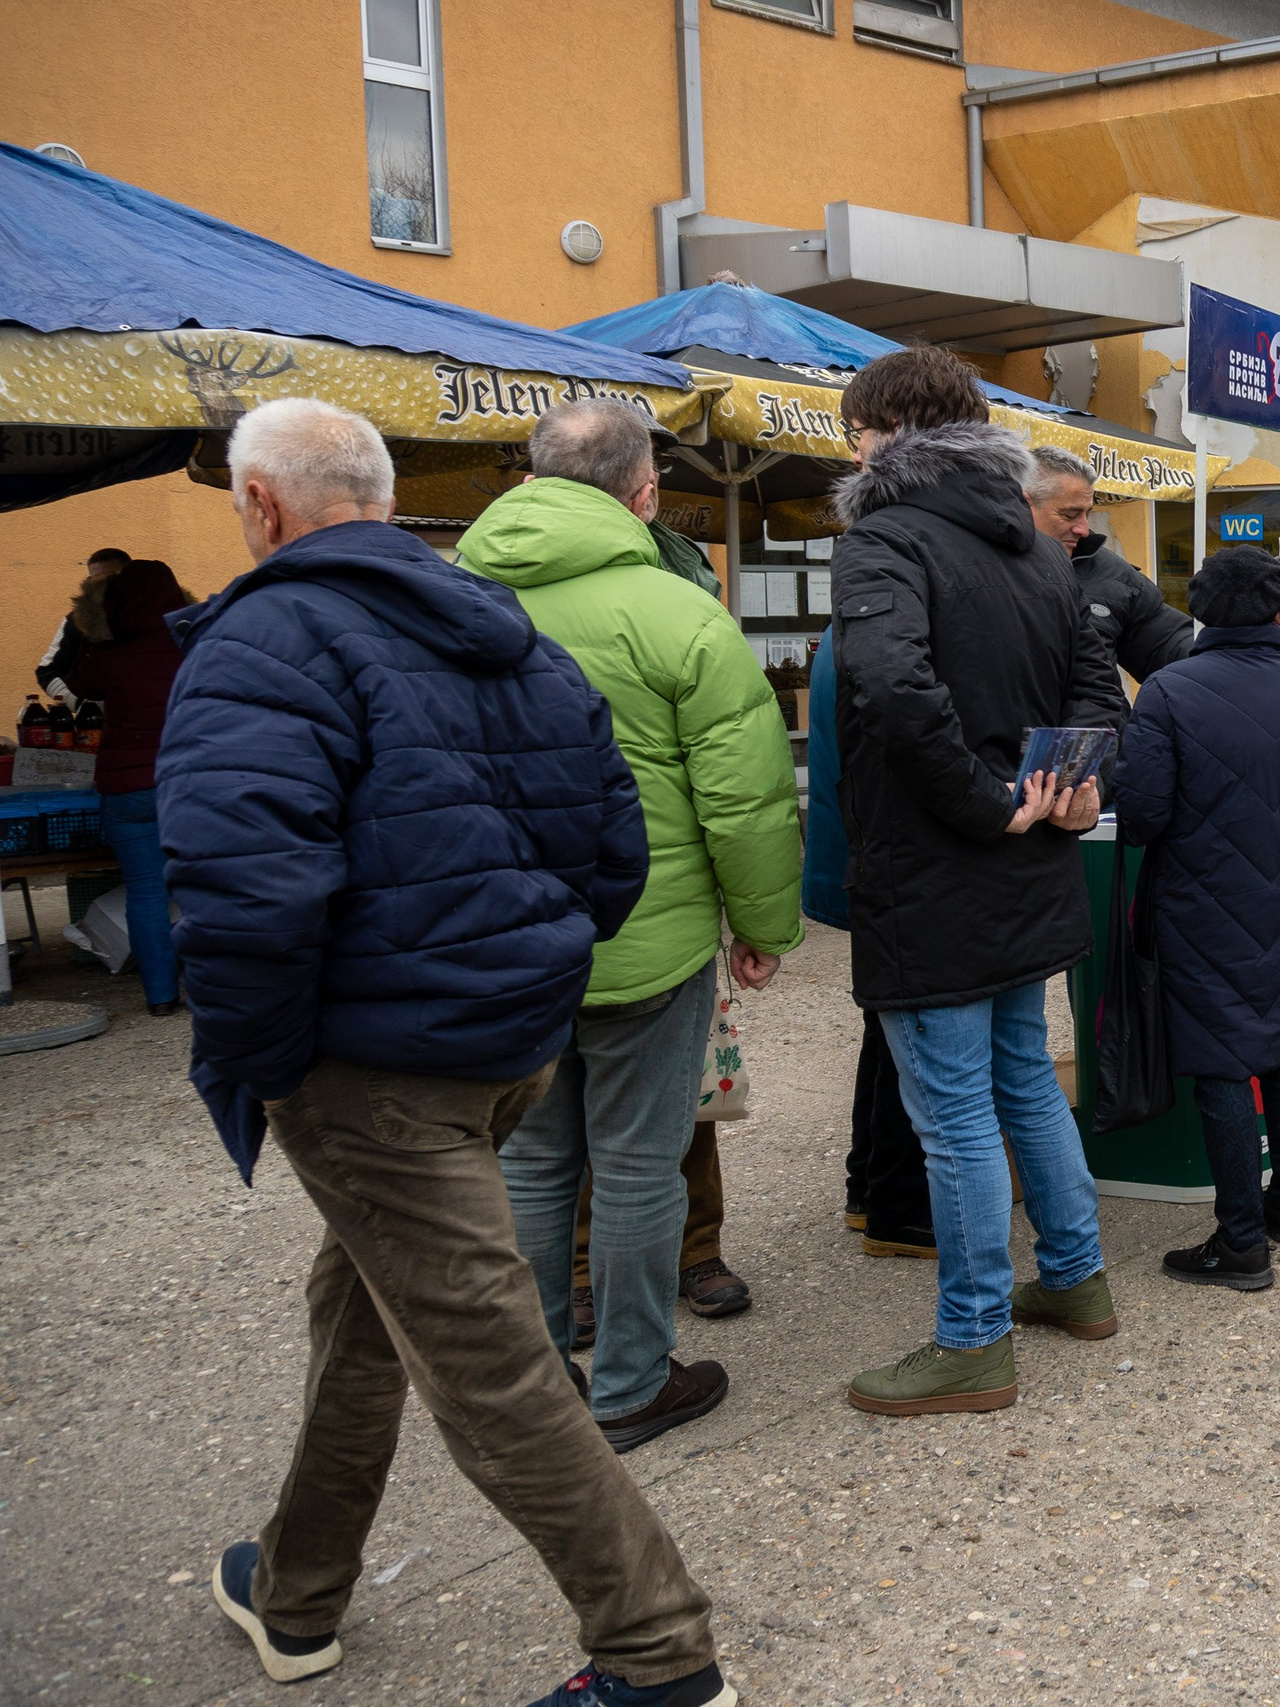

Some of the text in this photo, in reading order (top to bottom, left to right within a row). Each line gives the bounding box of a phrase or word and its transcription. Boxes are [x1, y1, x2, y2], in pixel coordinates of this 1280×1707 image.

[1229, 349, 1267, 374] СРБИЈА
[1229, 364, 1267, 389] ПРОТИВ
[434, 363, 555, 424] Jelen
[1228, 380, 1268, 405] НАСИЉА
[757, 392, 840, 441] Jelen
[1088, 443, 1197, 491] Jelen Pivo
[1224, 518, 1260, 536] WC
